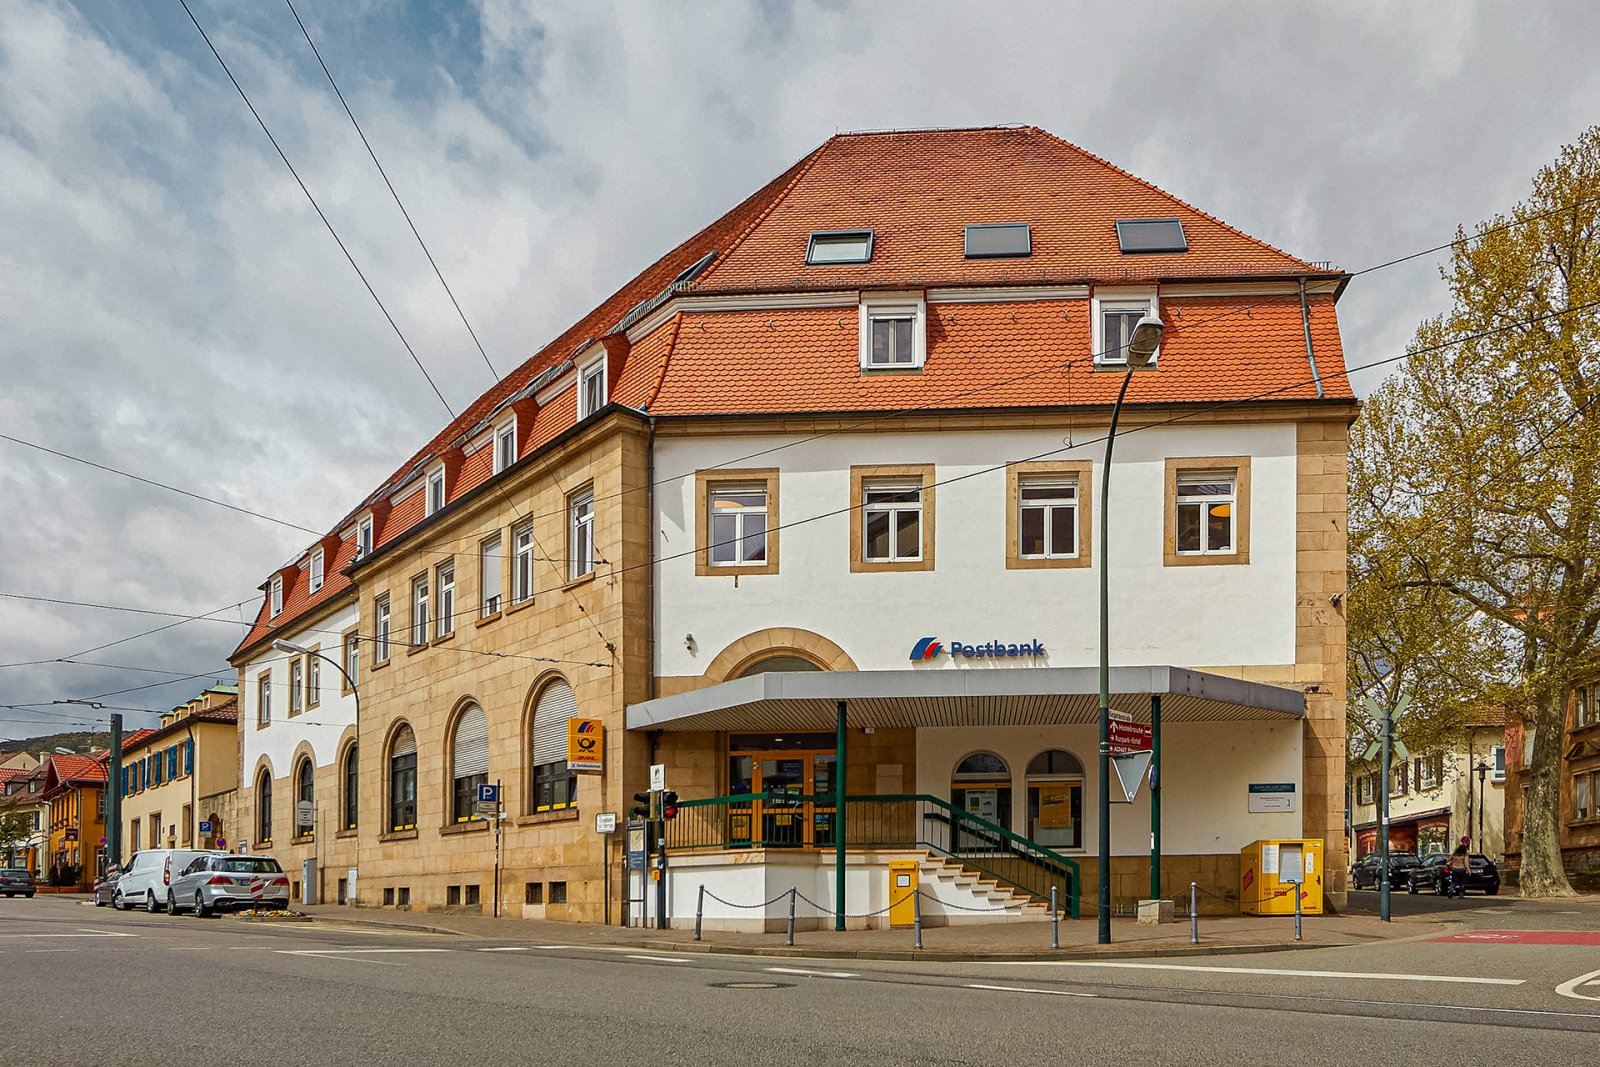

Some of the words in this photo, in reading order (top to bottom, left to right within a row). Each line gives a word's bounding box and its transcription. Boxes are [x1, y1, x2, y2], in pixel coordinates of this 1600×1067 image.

[951, 638, 1044, 659] Postbank
[1118, 724, 1143, 734] Hotelroute
[482, 786, 493, 800] P
[201, 822, 210, 831] P
